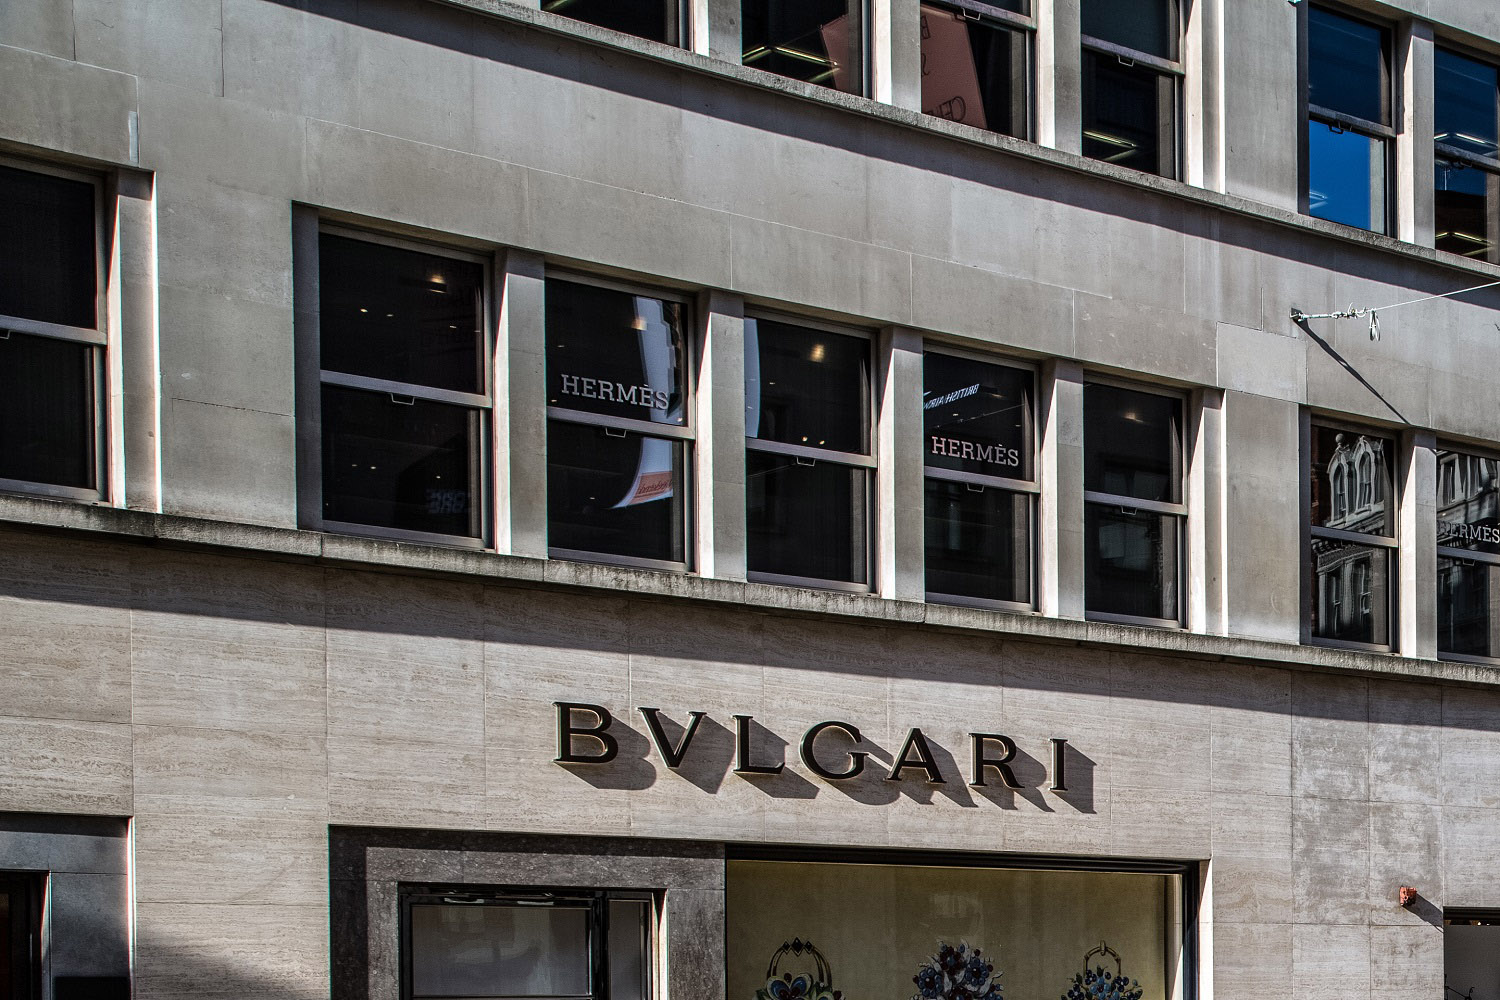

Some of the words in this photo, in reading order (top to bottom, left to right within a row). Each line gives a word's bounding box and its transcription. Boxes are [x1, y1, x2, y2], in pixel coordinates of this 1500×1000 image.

[561, 374, 670, 410] HERMÈS
[931, 436, 1019, 467] HERMÈS
[553, 701, 1069, 792] BVLGARI
